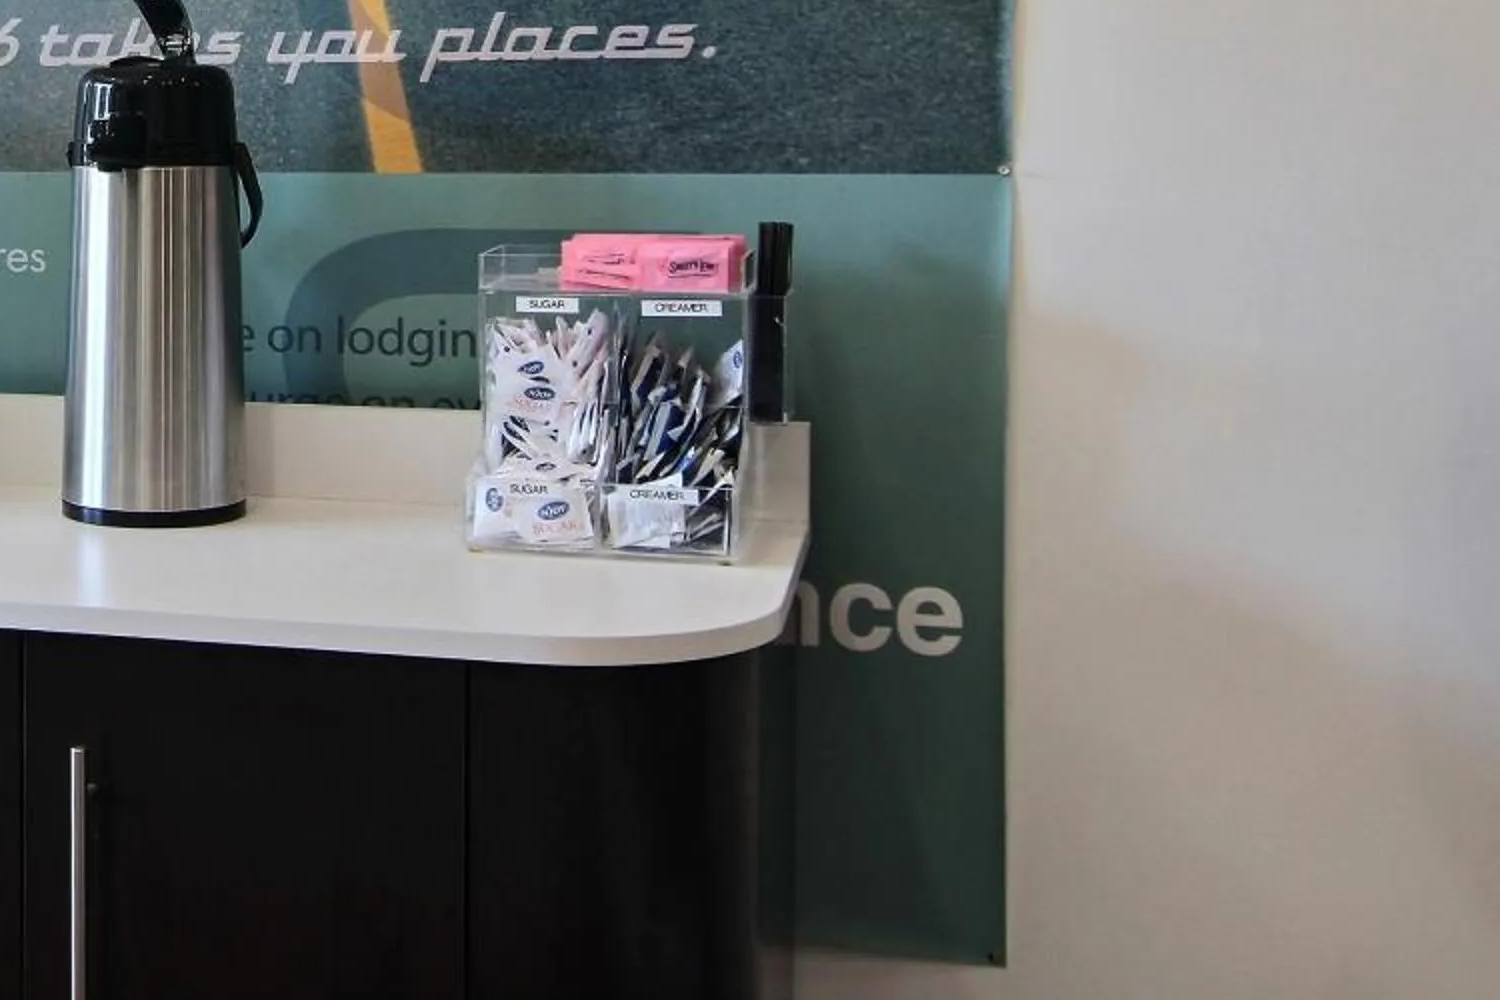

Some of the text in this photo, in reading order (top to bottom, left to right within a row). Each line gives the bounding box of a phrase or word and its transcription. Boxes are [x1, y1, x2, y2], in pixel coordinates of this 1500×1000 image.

[39, 17, 245, 69] taks
[267, 29, 407, 85] you
[419, 10, 717, 84] places.
[528, 299, 566, 311] SUGAR
[654, 302, 708, 313] CREAMER
[267, 323, 322, 354] on
[336, 315, 478, 368] lodgin
[509, 483, 549, 495] SUGAR
[629, 489, 685, 501] CREAMER
[795, 580, 964, 657] nce
